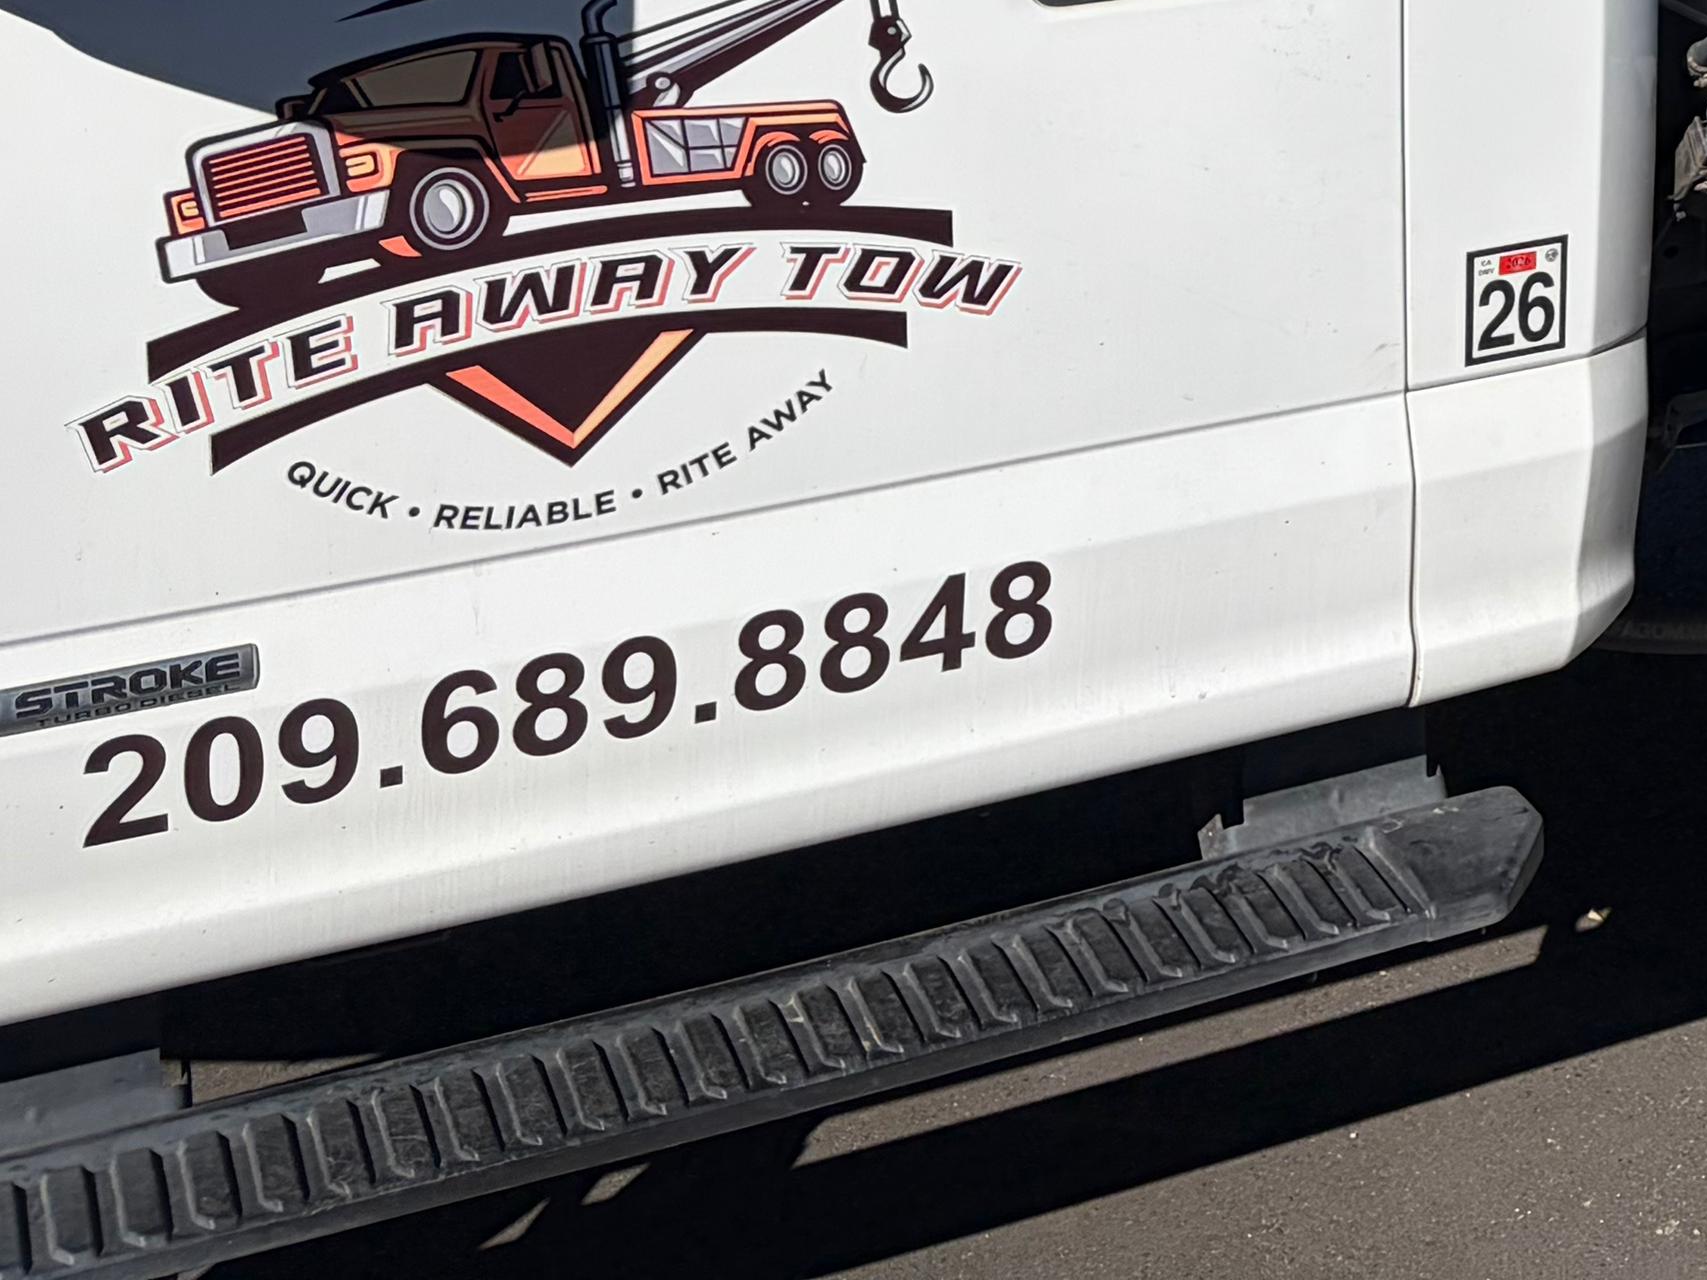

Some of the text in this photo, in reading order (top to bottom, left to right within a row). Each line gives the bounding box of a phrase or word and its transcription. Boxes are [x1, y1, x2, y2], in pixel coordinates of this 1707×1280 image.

[68, 242, 1022, 473] RITE AWAY TOW
[1477, 271, 1556, 352] 26
[287, 369, 833, 530] QUICK RELIABLE RITE AWAY
[14, 652, 241, 719] STROKE
[82, 560, 1053, 848] 209.689.8848
